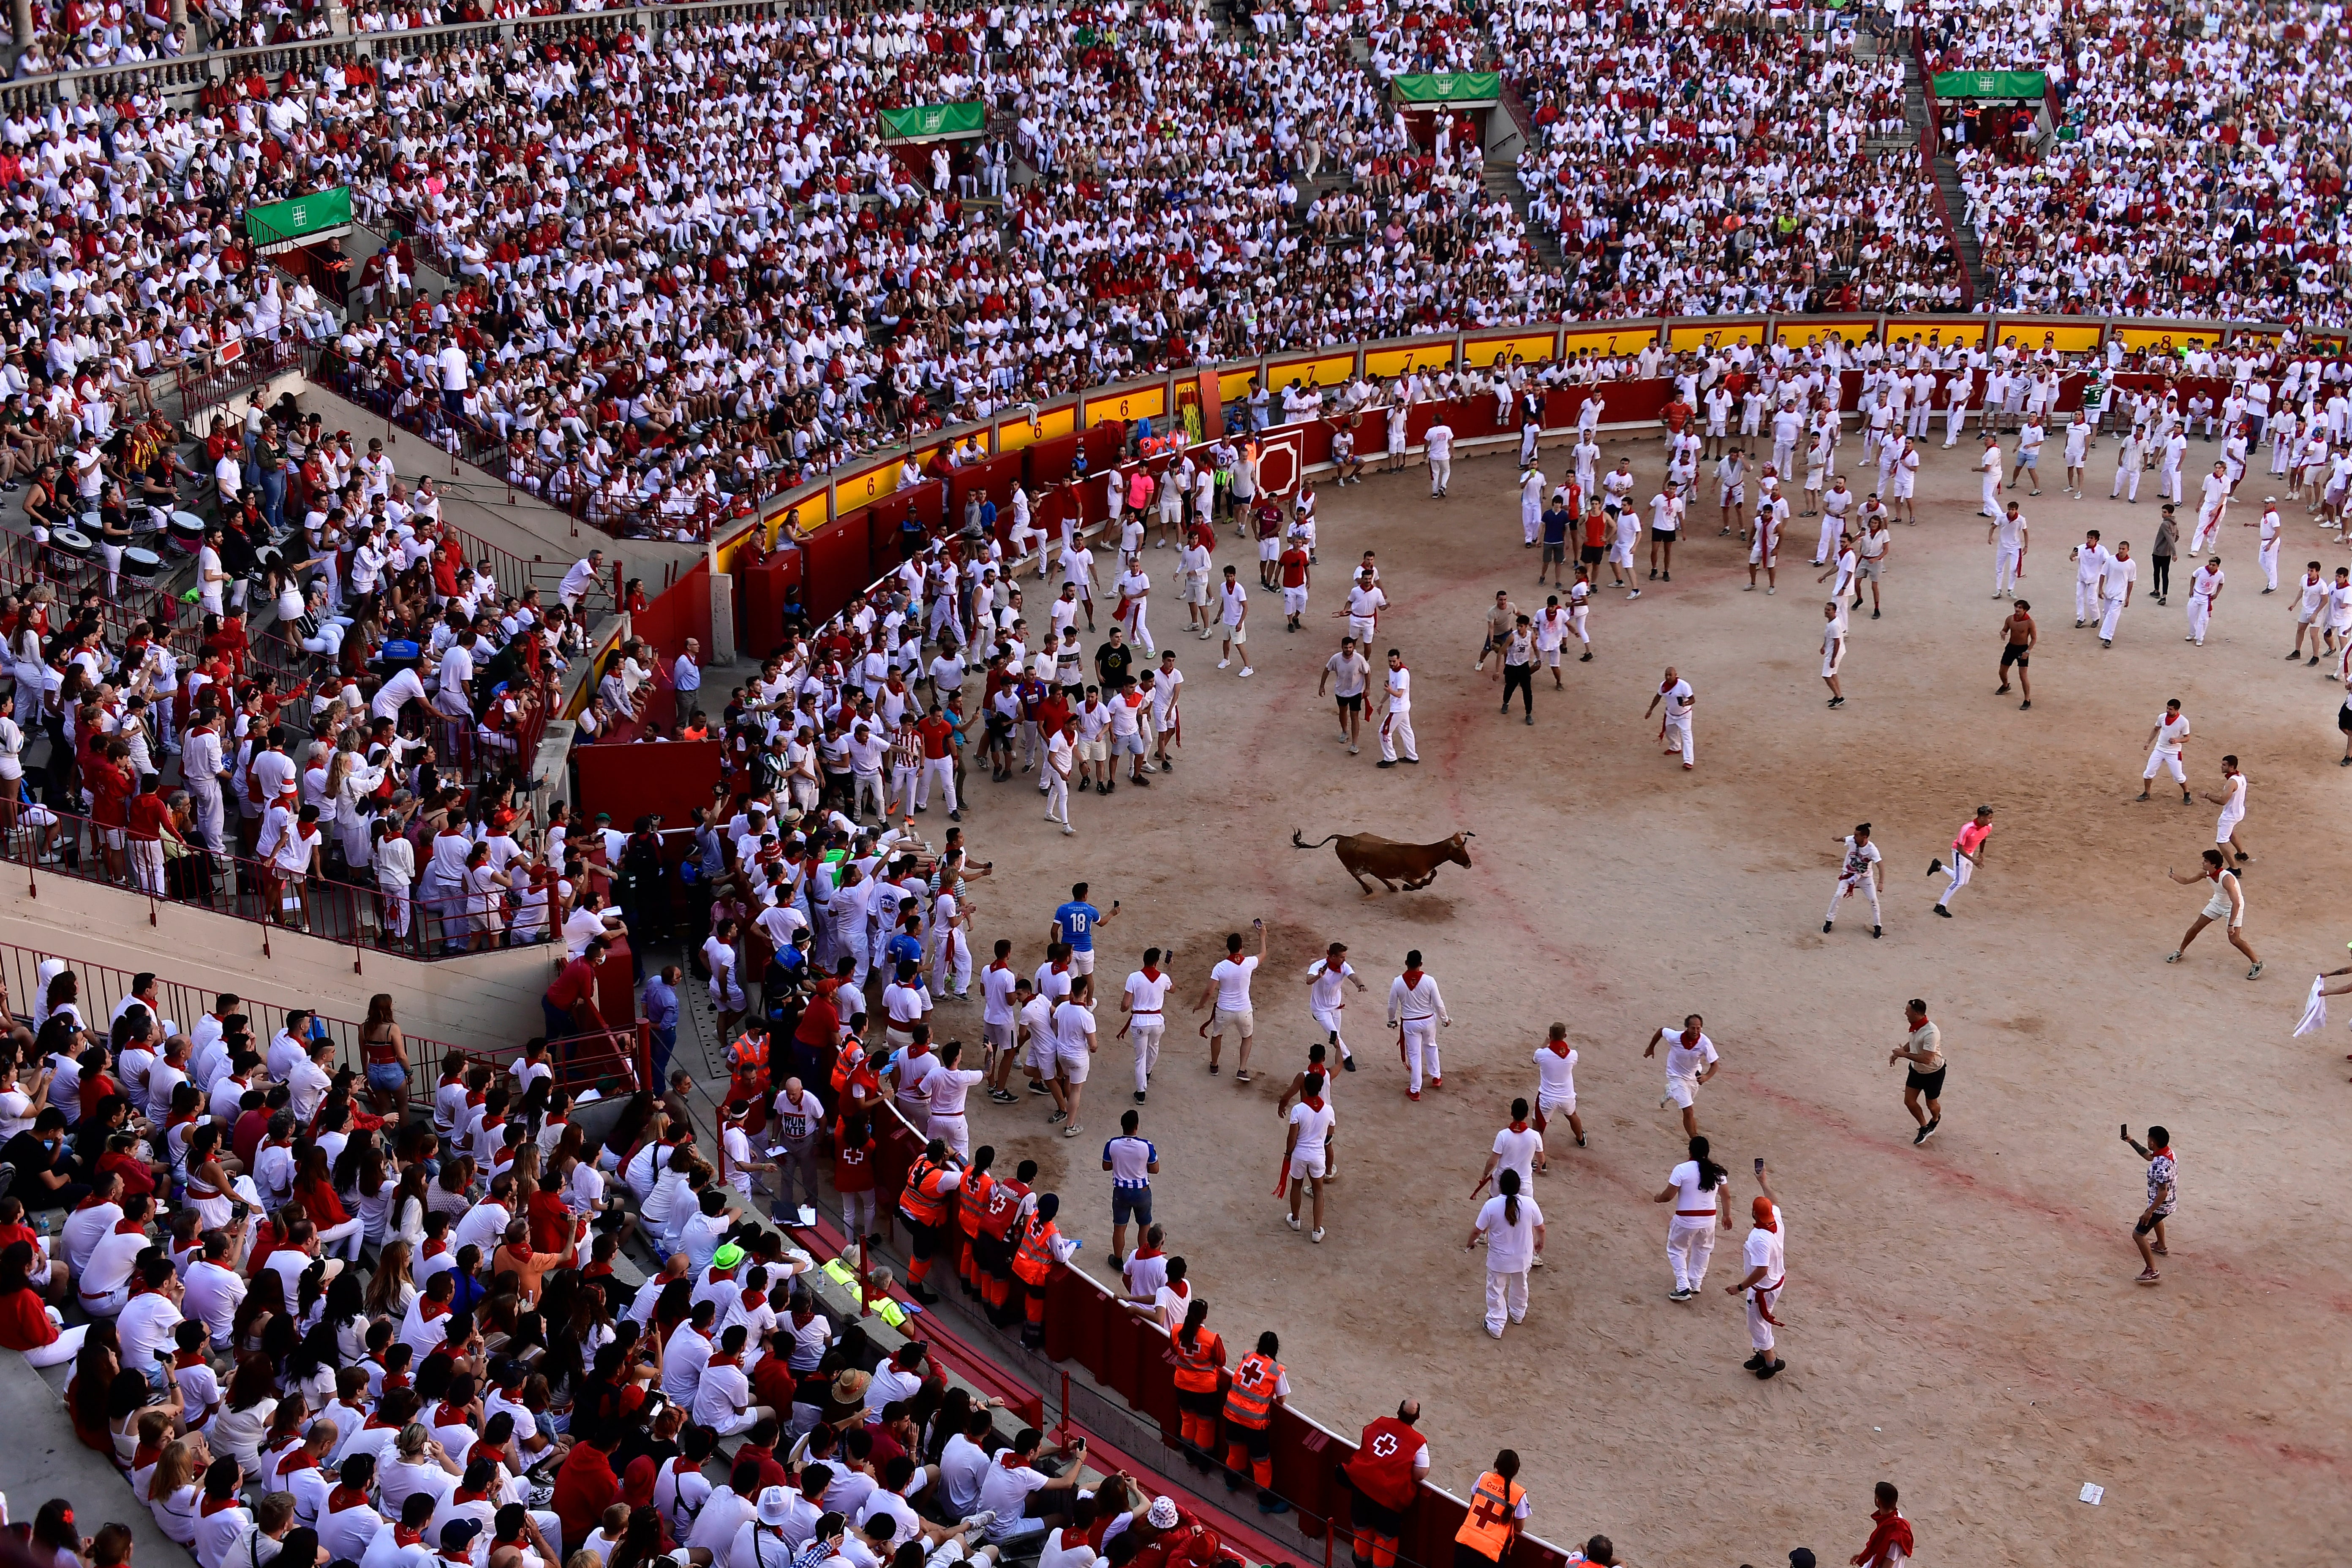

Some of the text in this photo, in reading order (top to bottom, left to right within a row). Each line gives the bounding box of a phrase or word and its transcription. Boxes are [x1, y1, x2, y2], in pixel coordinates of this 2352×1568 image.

[1713, 331, 1722, 346] 7
[1821, 329, 1831, 339] 7
[1608, 336, 1617, 351] 7
[2161, 335, 2171, 350] 8
[1505, 343, 1515, 359] 7
[1405, 353, 1414, 368] 7
[1307, 365, 1315, 381] 7
[2094, 391, 2100, 401] 5
[1120, 400, 1129, 416] 6
[1034, 421, 1042, 439] 6
[867, 477, 875, 495] 6
[1070, 913, 1086, 932] 18
[784, 1116, 806, 1127] RUN
[785, 1123, 806, 1135] WTB
[1487, 1481, 1498, 1490] Cruz
